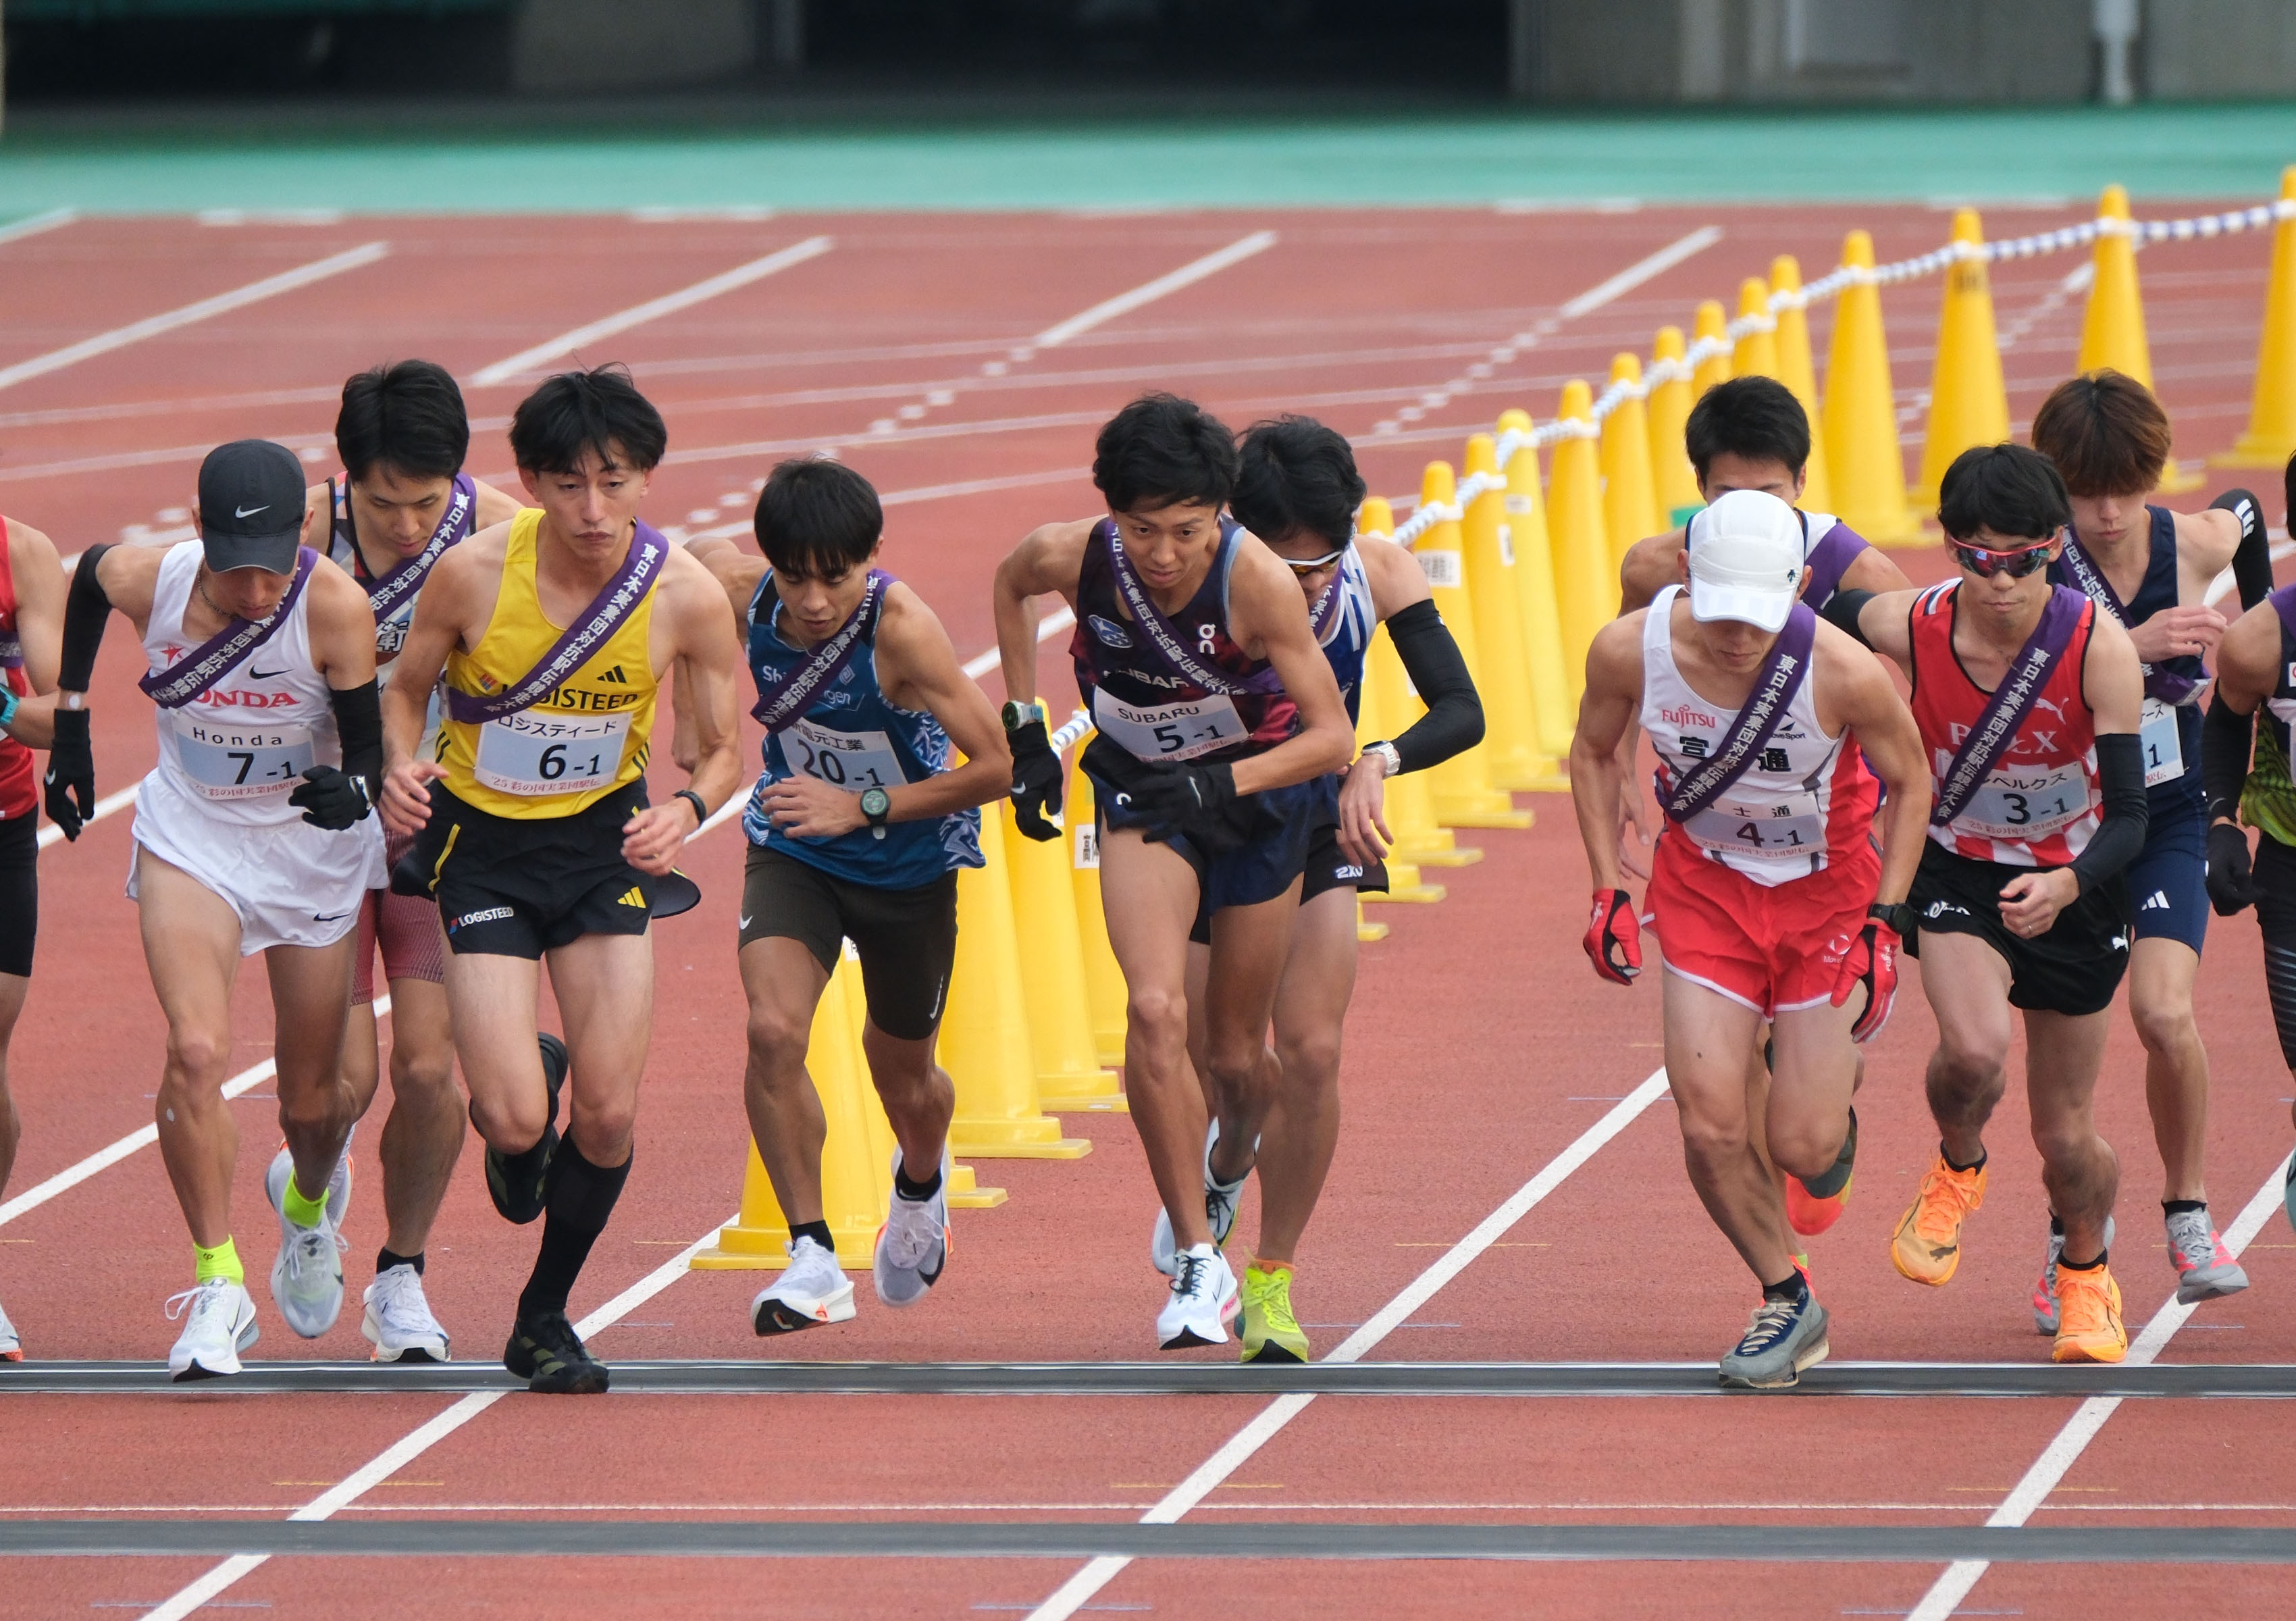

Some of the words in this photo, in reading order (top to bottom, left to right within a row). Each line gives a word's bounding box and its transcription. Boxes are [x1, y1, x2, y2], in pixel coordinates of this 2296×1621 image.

[194, 690, 301, 709] ONDA
[502, 682, 637, 711] ISTEED
[498, 715, 617, 738] ロジスティード
[1118, 706, 1200, 723] SUBARU
[1661, 704, 1716, 728] FUJITSU
[192, 726, 282, 746] Honda
[1153, 724, 1224, 753] 5-1
[1771, 732, 1806, 741] oveSport
[1936, 647, 2051, 819] 東日本実業団対抗駅伝競走大会
[227, 752, 296, 785] 7-1
[539, 744, 601, 781] 6-1
[797, 738, 885, 787] 20-1
[1983, 772, 2068, 791] ベルクス
[2003, 793, 2070, 825] 3-1
[1736, 822, 1804, 848] 4-1
[1336, 865, 1363, 879] 2XU
[459, 906, 514, 927] LOGISTEED
